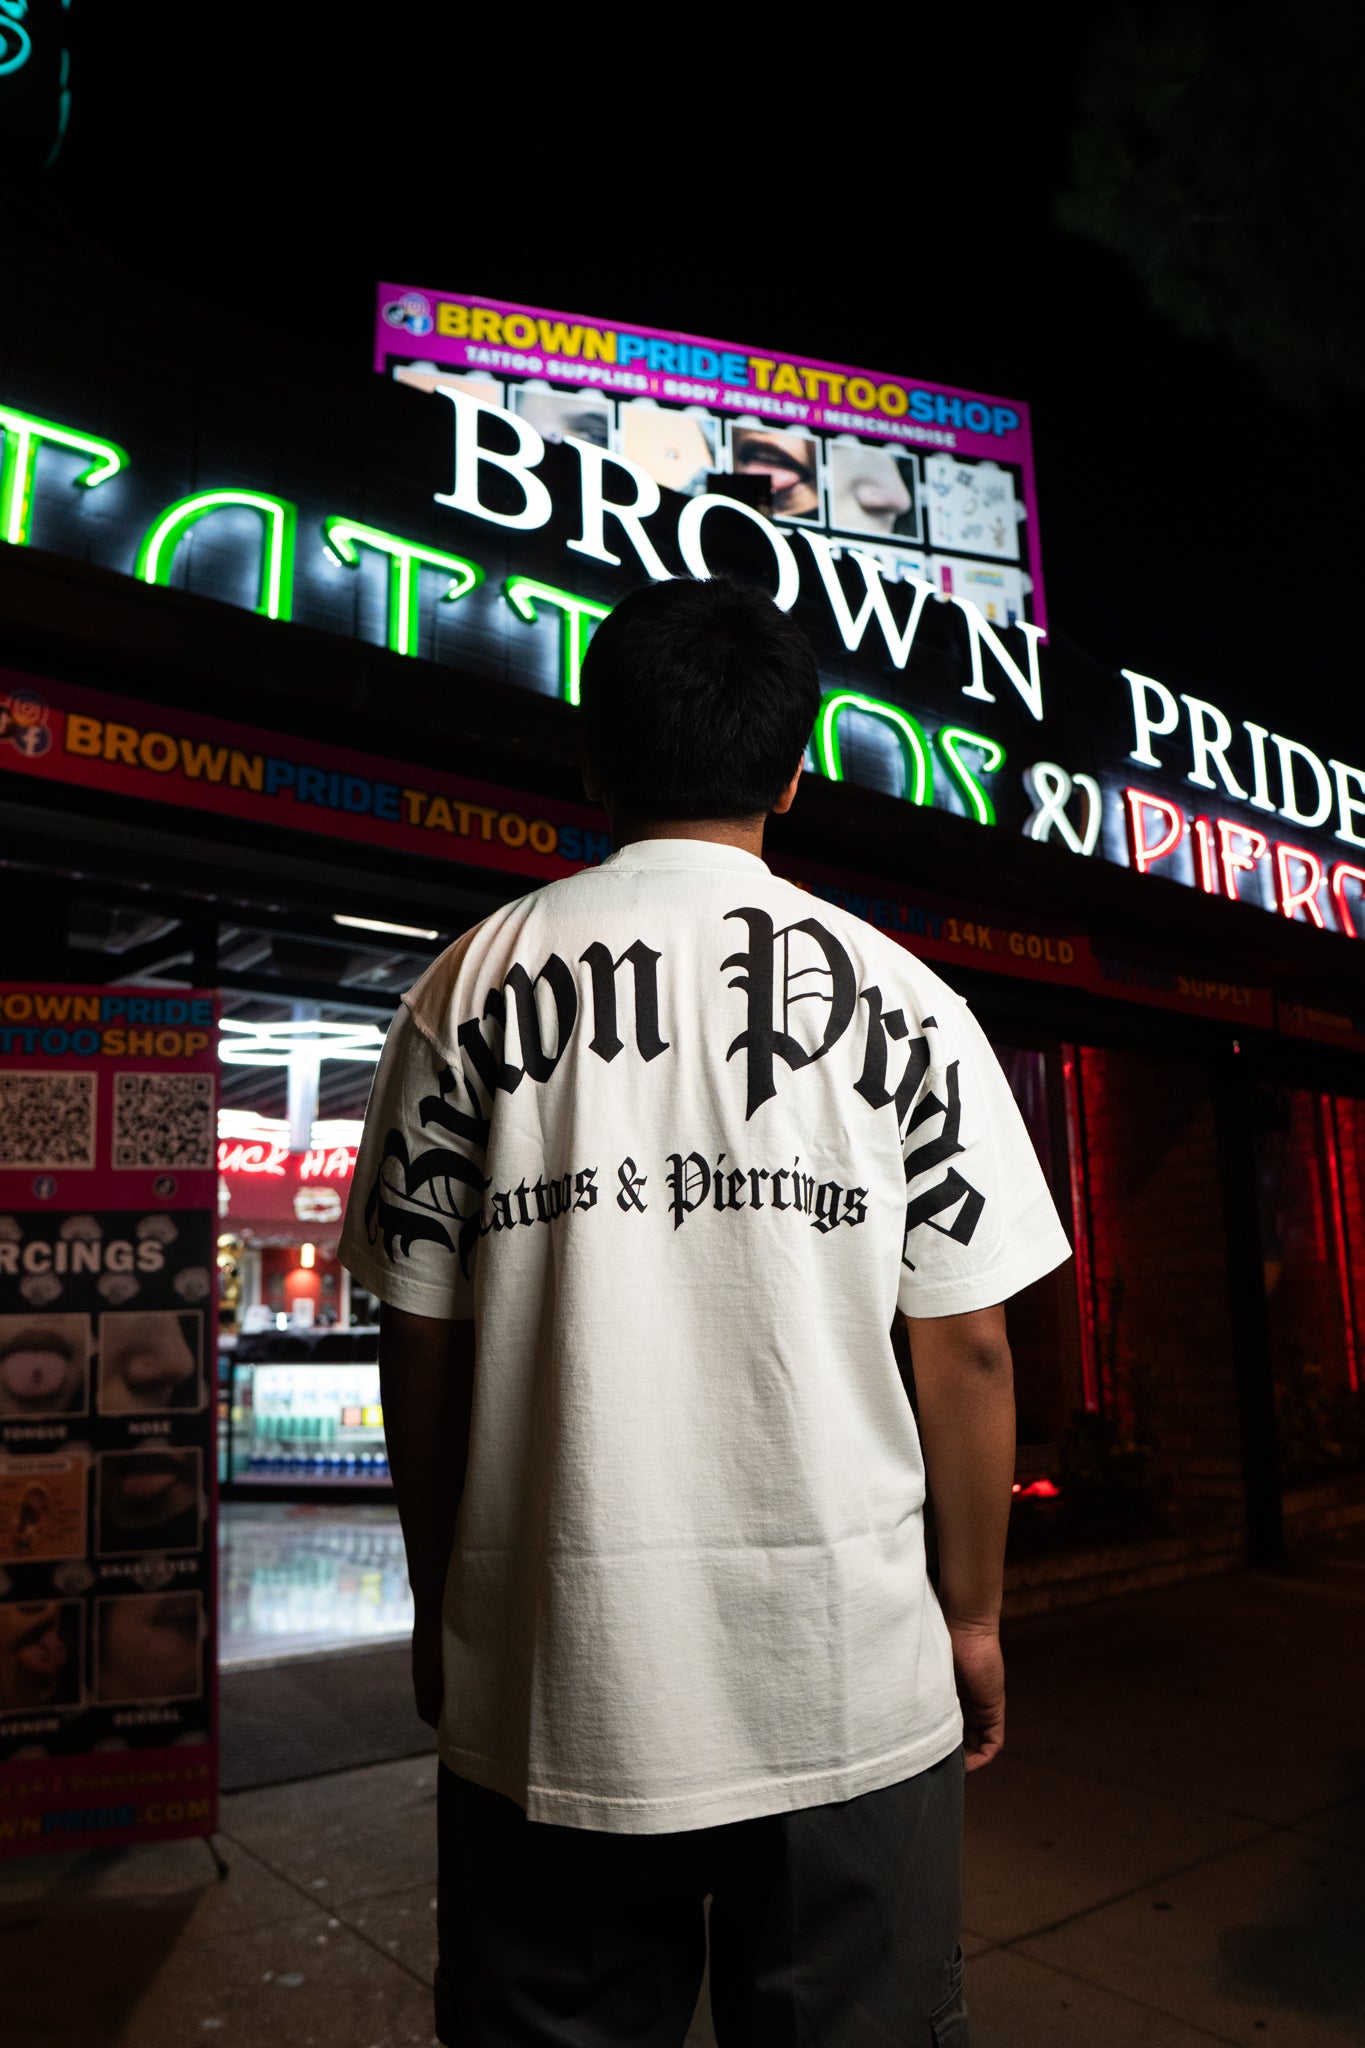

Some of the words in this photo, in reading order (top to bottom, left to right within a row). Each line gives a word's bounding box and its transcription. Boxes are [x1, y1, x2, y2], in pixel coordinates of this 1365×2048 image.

[464, 345, 543, 373] TATTOO
[546, 358, 649, 391] SUPPLIES
[663, 378, 719, 403] BODY
[721, 388, 811, 420] JEWELRY
[823, 408, 957, 448] MERCHANDISE
[433, 384, 1047, 721] BROWN
[947, 916, 991, 950] 14K
[1007, 930, 1077, 966] GOLD
[0, 992, 214, 1027] OWNPRIDE
[363, 937, 671, 1282] Brown
[719, 906, 987, 1273] Pride
[616, 1156, 648, 1214] &
[665, 1151, 869, 1235] Piercings
